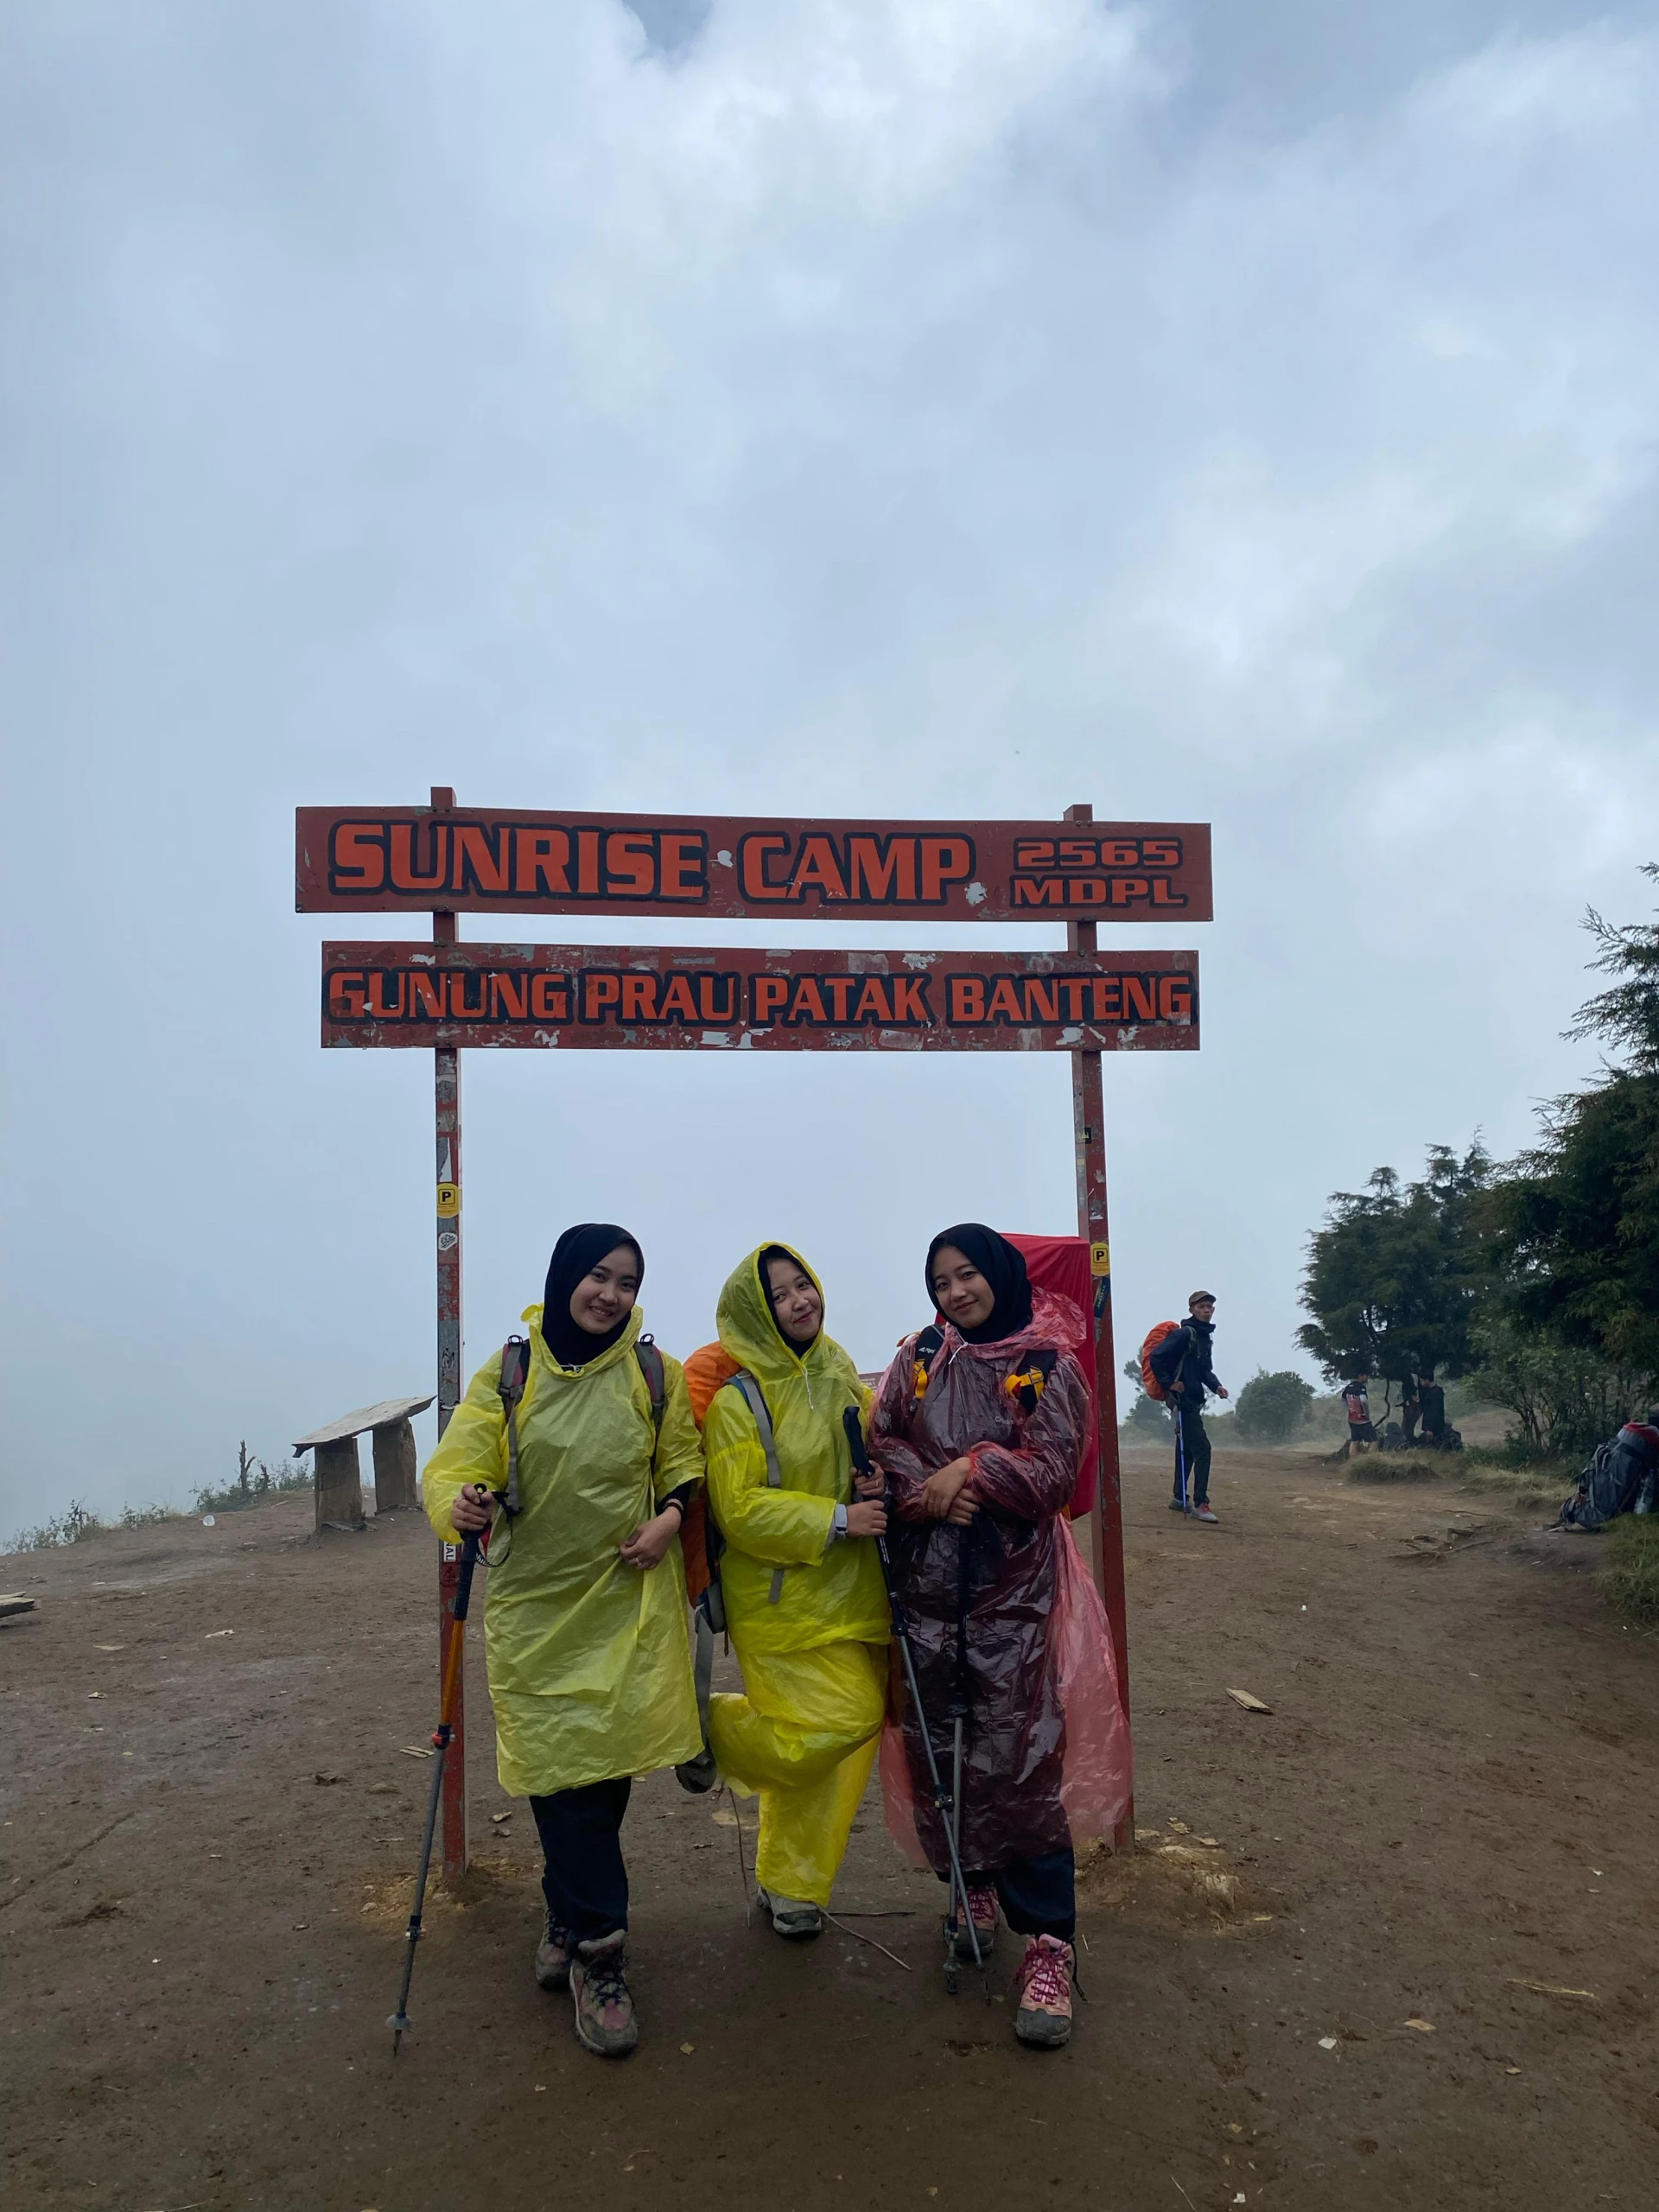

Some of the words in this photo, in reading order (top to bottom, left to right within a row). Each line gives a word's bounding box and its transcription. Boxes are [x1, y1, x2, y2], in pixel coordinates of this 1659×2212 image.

[333, 823, 704, 899] SUNRISE
[742, 835, 970, 900] CAMP
[1017, 840, 1179, 867] 2565
[1014, 877, 1187, 905] MDPL
[327, 970, 569, 1020] GUNUNG
[584, 974, 734, 1021] PRAU
[753, 976, 927, 1021] PATAK
[950, 976, 1193, 1026] BANTENG
[442, 1191, 452, 1202] P
[1096, 1250, 1105, 1262] P
